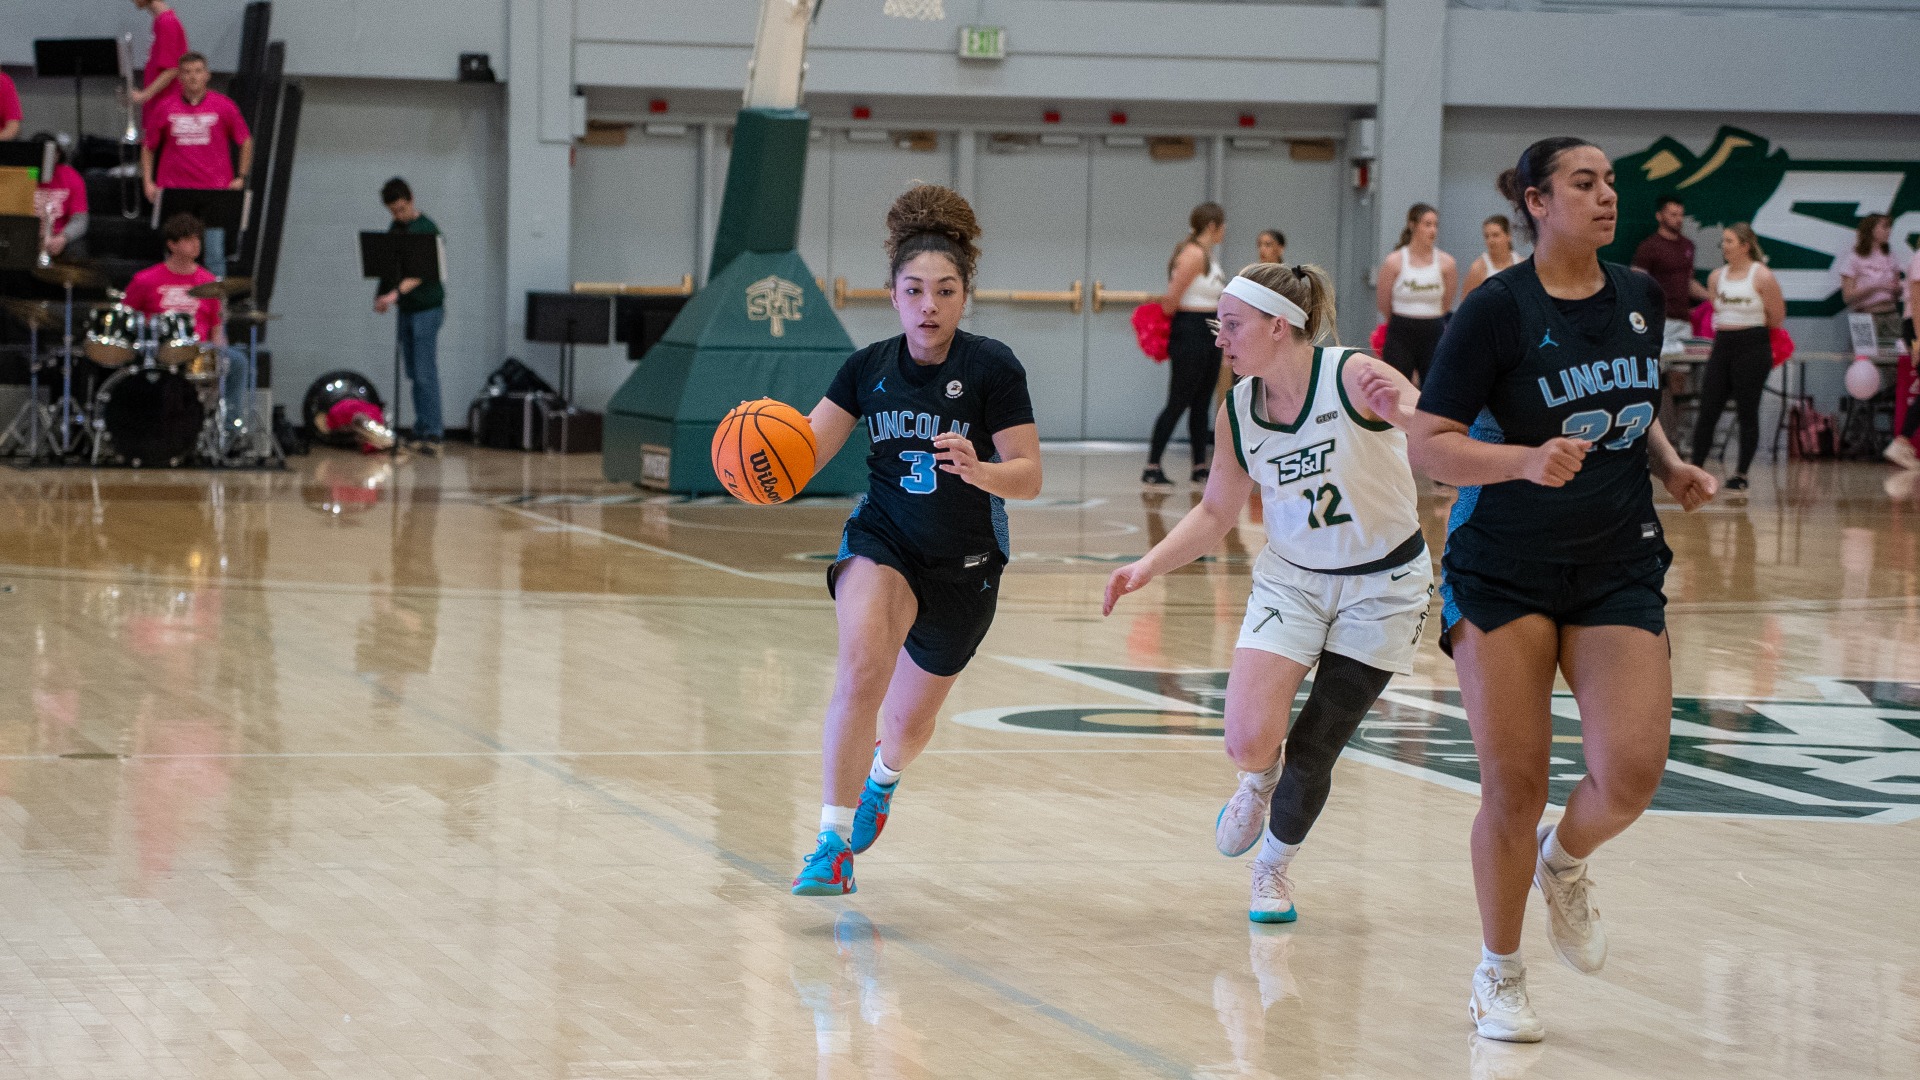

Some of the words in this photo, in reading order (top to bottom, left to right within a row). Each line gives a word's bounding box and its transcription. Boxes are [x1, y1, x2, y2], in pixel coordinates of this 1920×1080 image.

[1750, 169, 1920, 303] S
[1538, 356, 1659, 408] LINCOLN
[868, 410, 970, 444] LINCOLN
[1562, 401, 1654, 450] 23
[749, 448, 784, 503] Wilson
[899, 450, 937, 494] 3
[1267, 438, 1335, 486] S&T
[1302, 482, 1353, 530] 12
